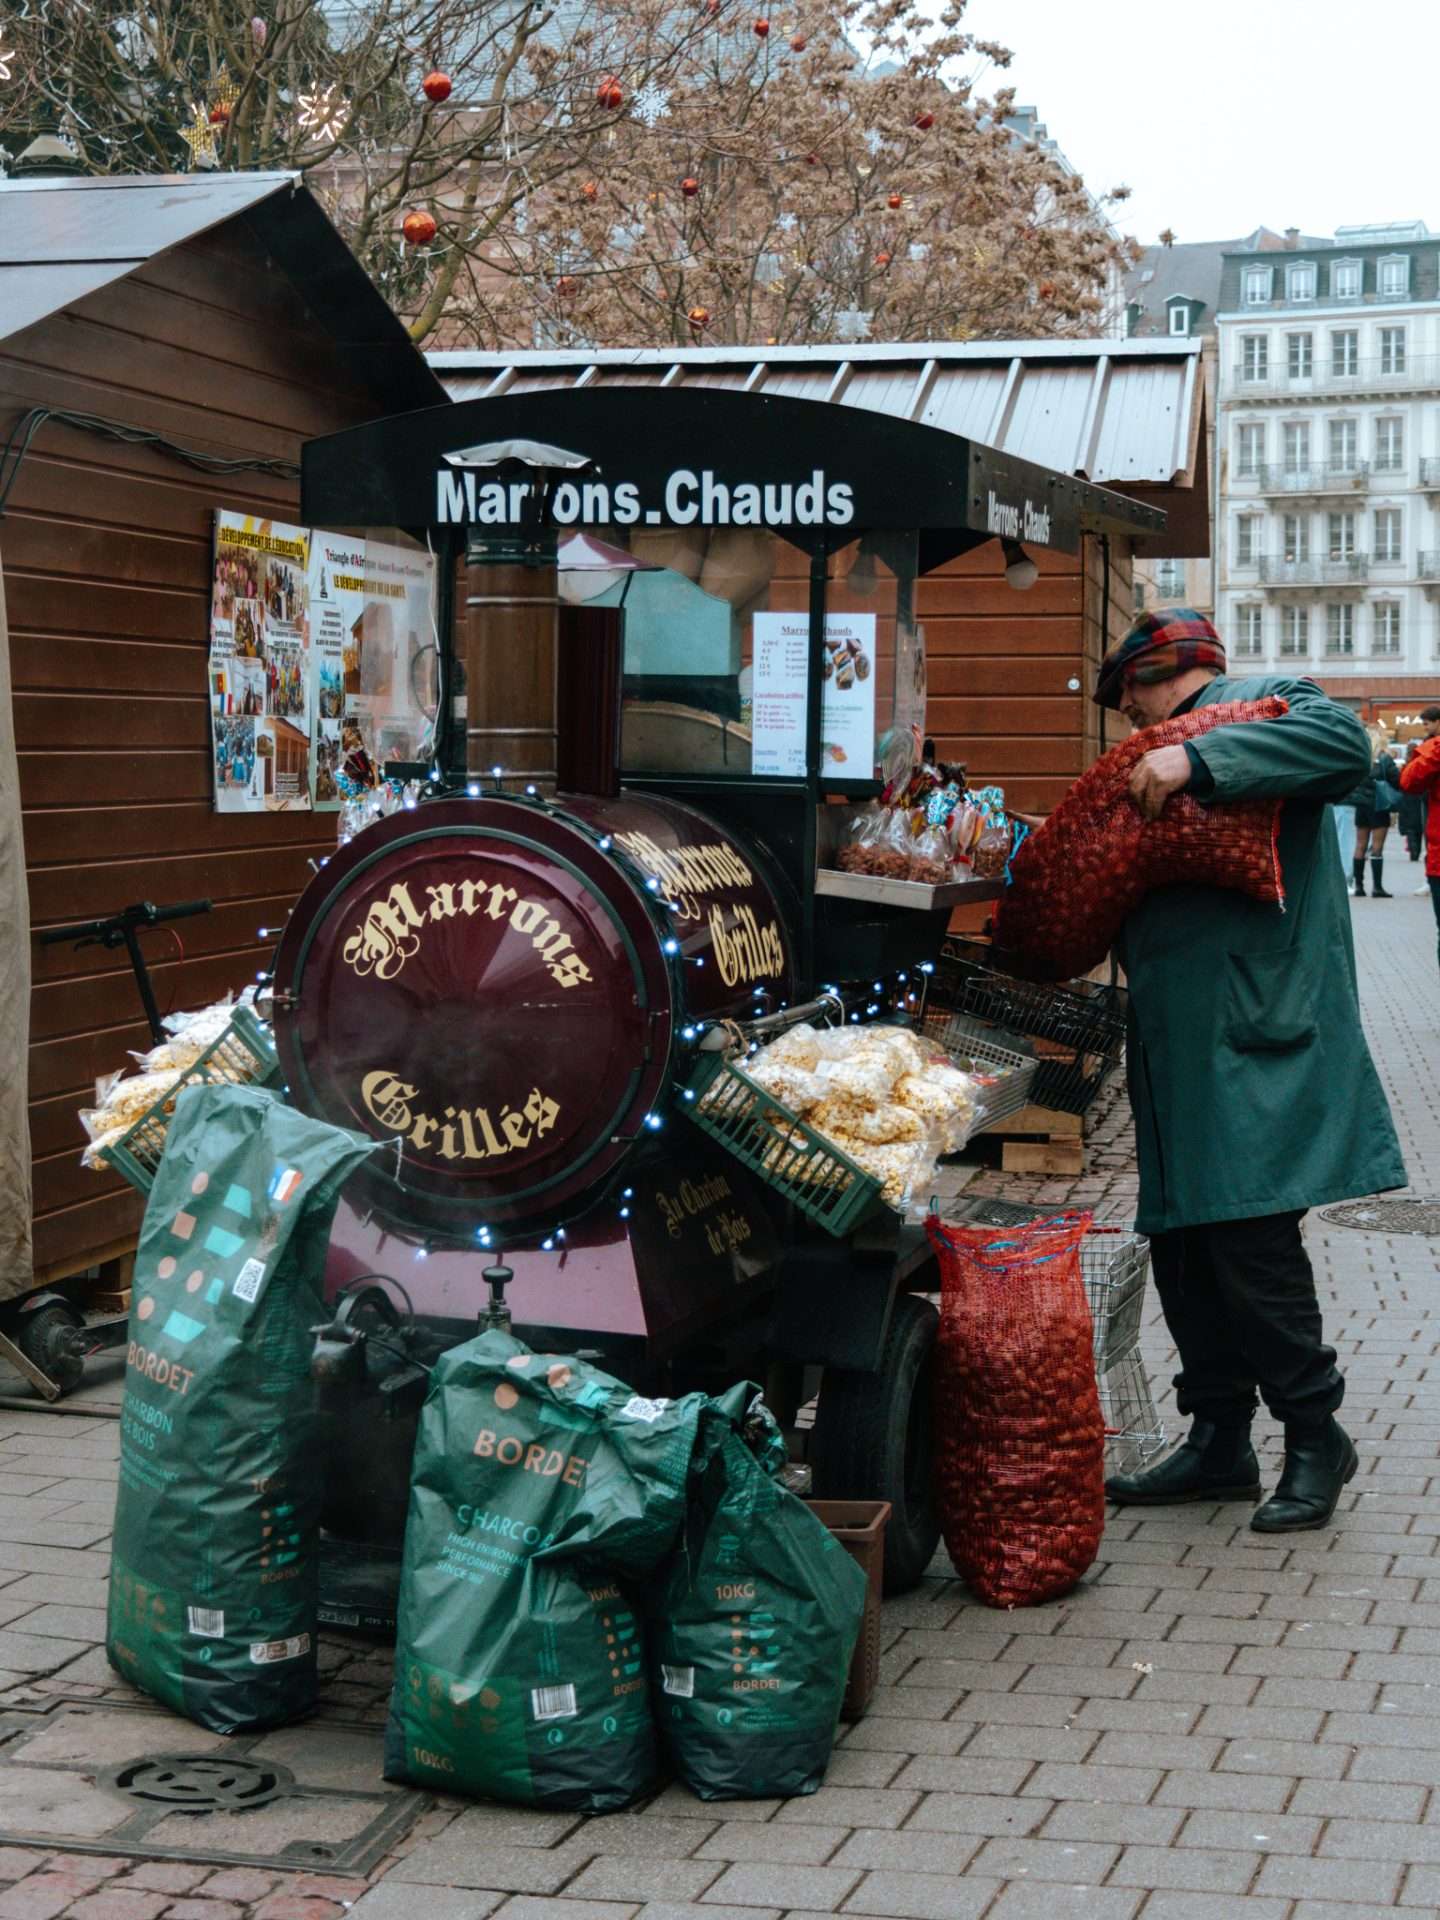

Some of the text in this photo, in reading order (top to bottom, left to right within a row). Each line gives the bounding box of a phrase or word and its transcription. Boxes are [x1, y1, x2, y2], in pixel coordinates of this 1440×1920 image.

[664, 470, 856, 525] Chauds
[614, 831, 752, 920] Marrons
[343, 879, 593, 988] Marrons
[361, 1070, 561, 1159] Grillés
[127, 1341, 195, 1395] BORDET
[473, 1429, 594, 1488] BORDE
[714, 1583, 756, 1600] 10KG
[732, 1679, 782, 1692] BORDET
